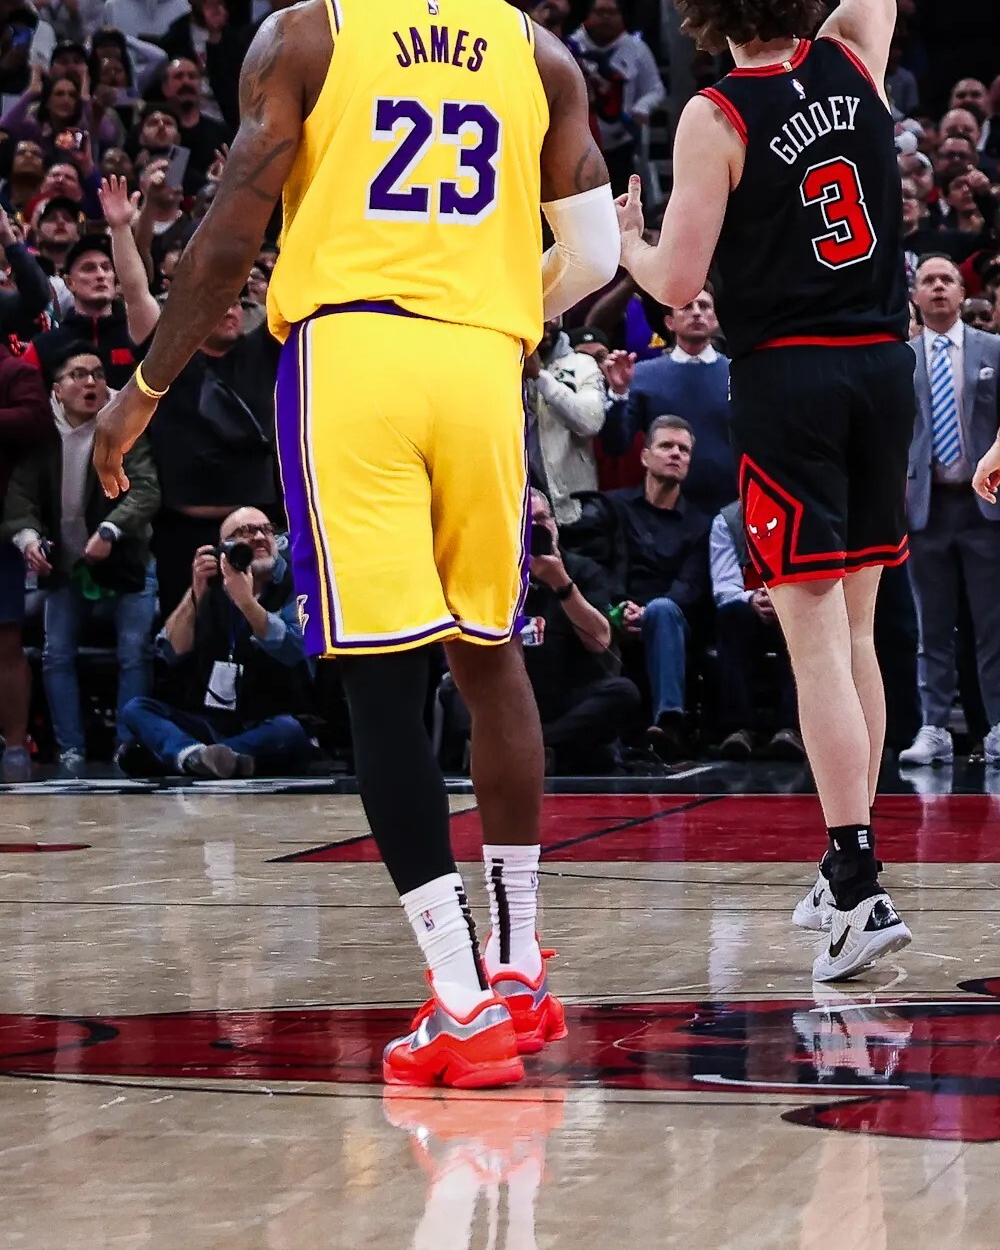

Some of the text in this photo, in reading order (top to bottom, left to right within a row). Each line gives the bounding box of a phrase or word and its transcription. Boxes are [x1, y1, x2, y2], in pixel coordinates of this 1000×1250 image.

[392, 24, 488, 73] JAMES
[364, 96, 503, 226] 23
[769, 95, 861, 165] GIDDEY
[800, 155, 877, 270] 3
